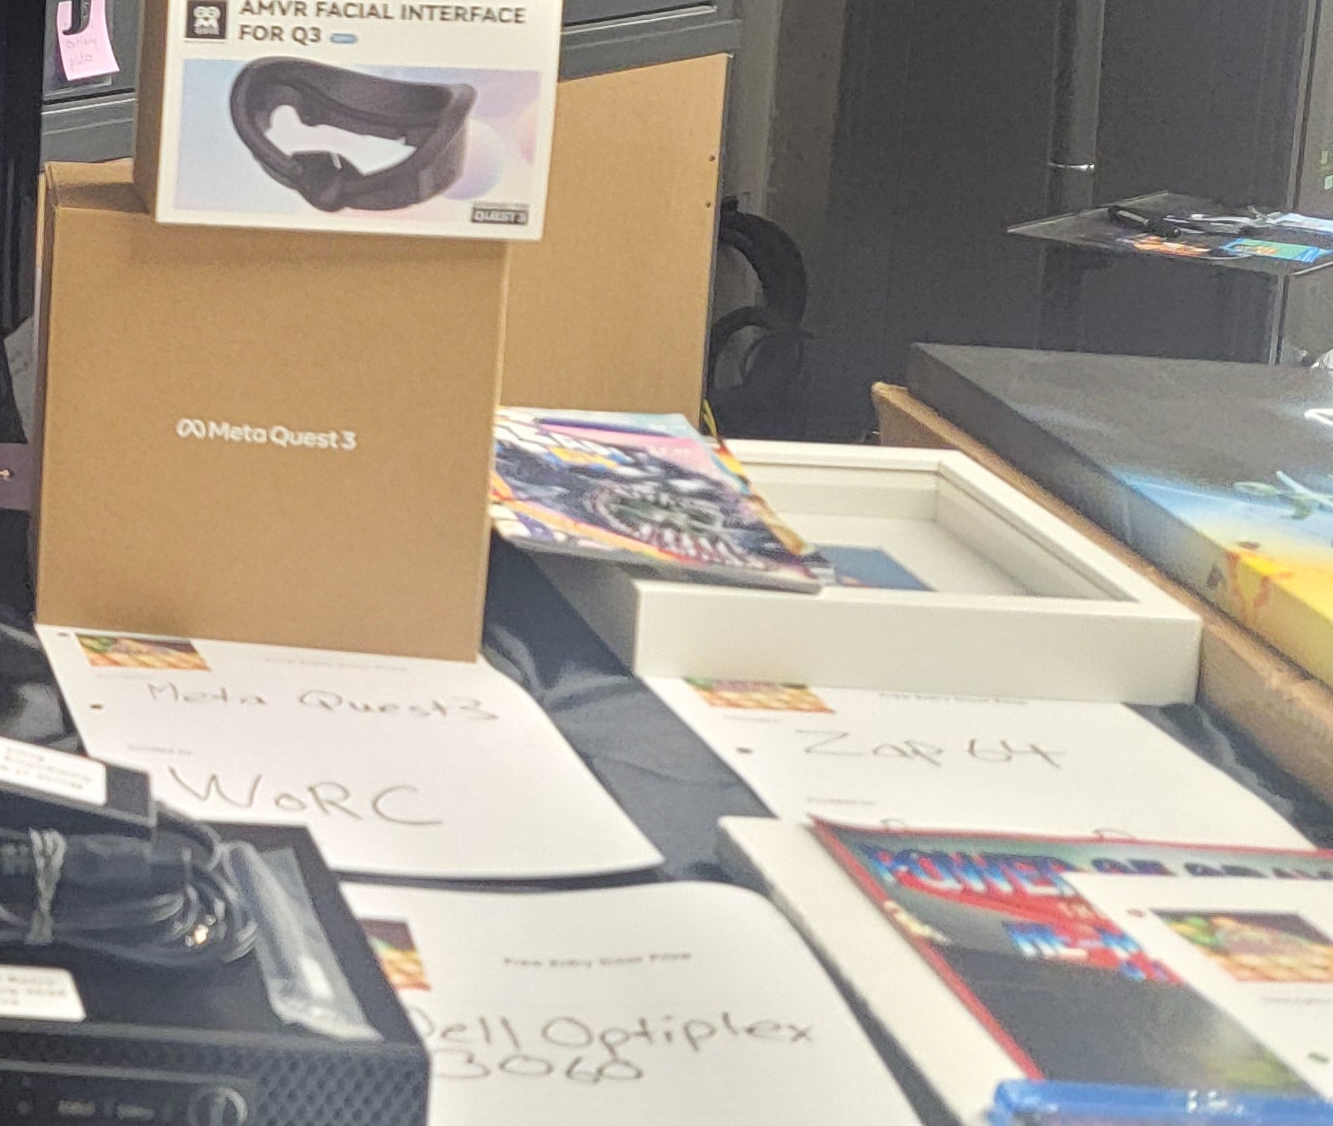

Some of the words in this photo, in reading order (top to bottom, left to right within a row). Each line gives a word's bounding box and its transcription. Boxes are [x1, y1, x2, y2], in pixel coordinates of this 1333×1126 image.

[315, 1, 397, 20] FACIAL
[400, 4, 527, 24] INTERFACE
[238, 24, 285, 42] FOR
[291, 26, 322, 46] Q3
[208, 421, 268, 444] Meta
[269, 425, 338, 449] Quest
[340, 430, 358, 452] 3
[146, 682, 269, 707] Meta
[541, 1011, 814, 1059] Optiplex
[432, 1047, 643, 1083] 3060
